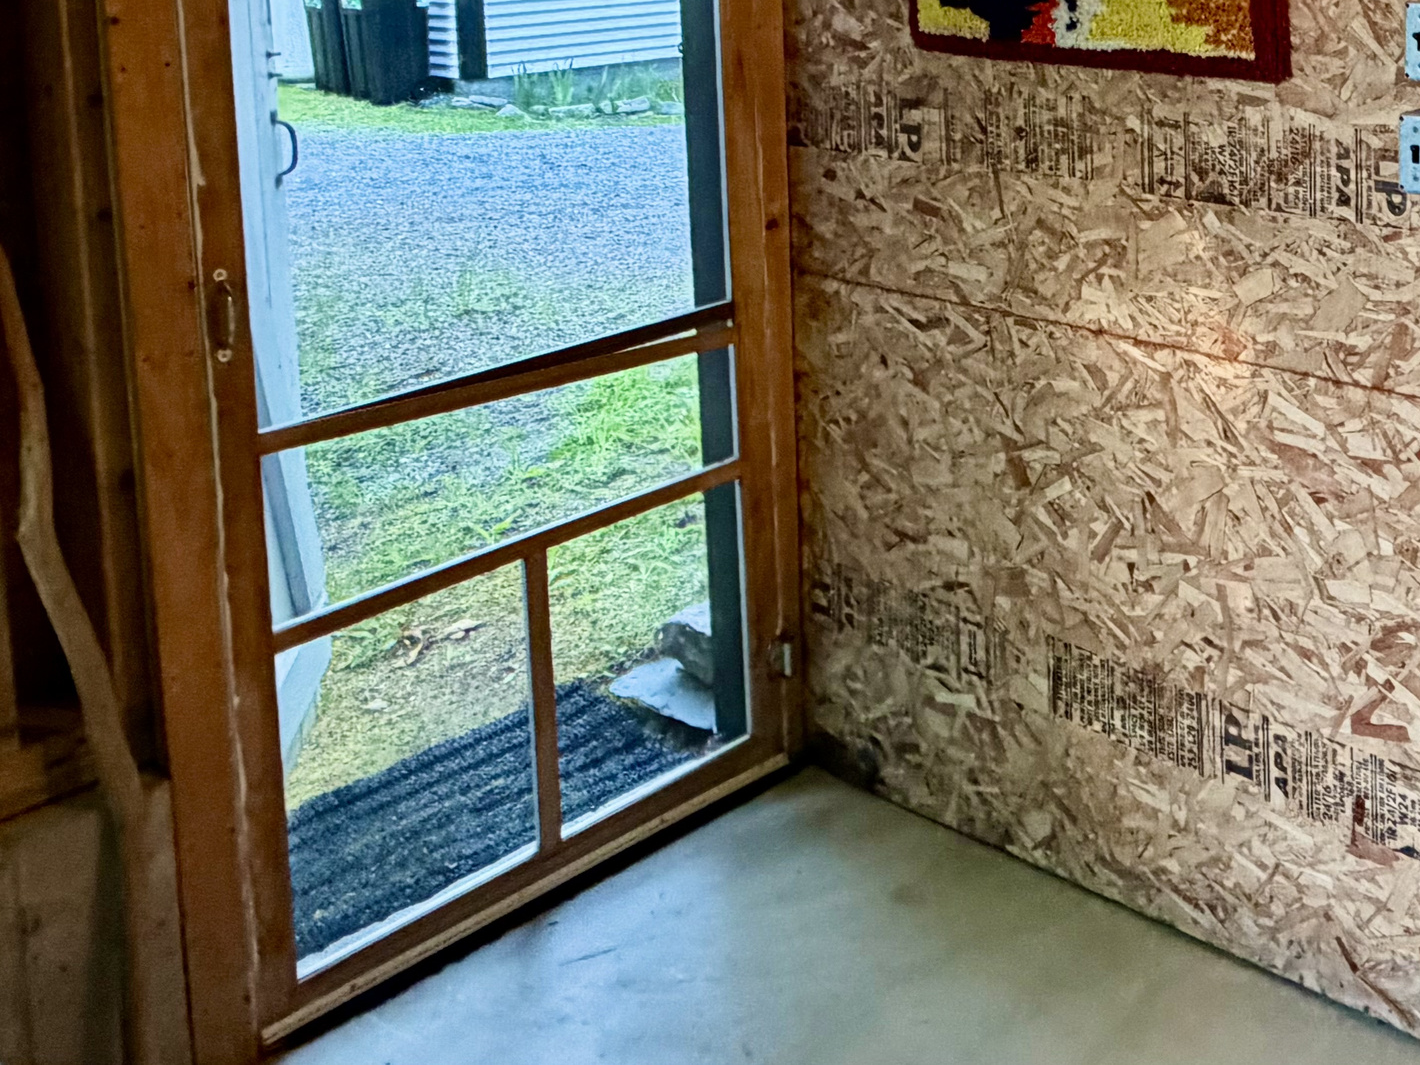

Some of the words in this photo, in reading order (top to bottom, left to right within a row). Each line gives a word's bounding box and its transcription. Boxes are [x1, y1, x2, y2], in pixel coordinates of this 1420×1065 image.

[1335, 138, 1352, 209] APA
[1224, 713, 1254, 782] LP
[1273, 732, 1289, 799] APA
[1322, 785, 1333, 821] 24/16
[1397, 793, 1409, 825] W24
